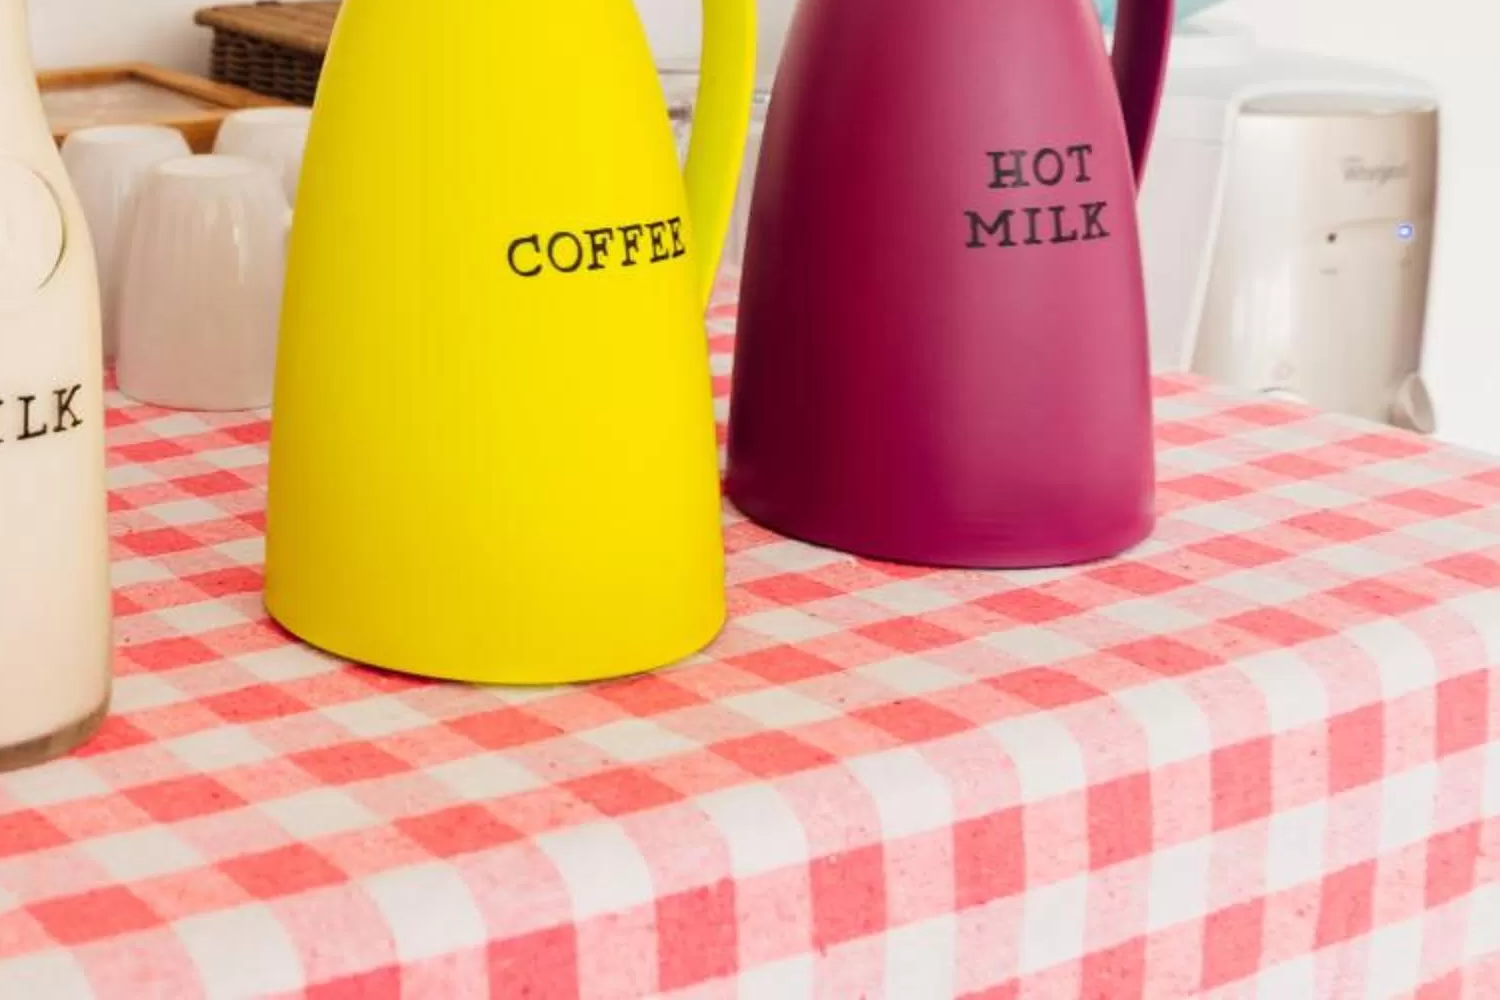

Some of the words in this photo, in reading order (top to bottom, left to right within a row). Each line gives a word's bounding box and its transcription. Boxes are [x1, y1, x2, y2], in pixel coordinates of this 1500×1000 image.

[986, 144, 1092, 188] HOT
[507, 216, 686, 277] COFFEE
[964, 201, 1110, 248] MILK
